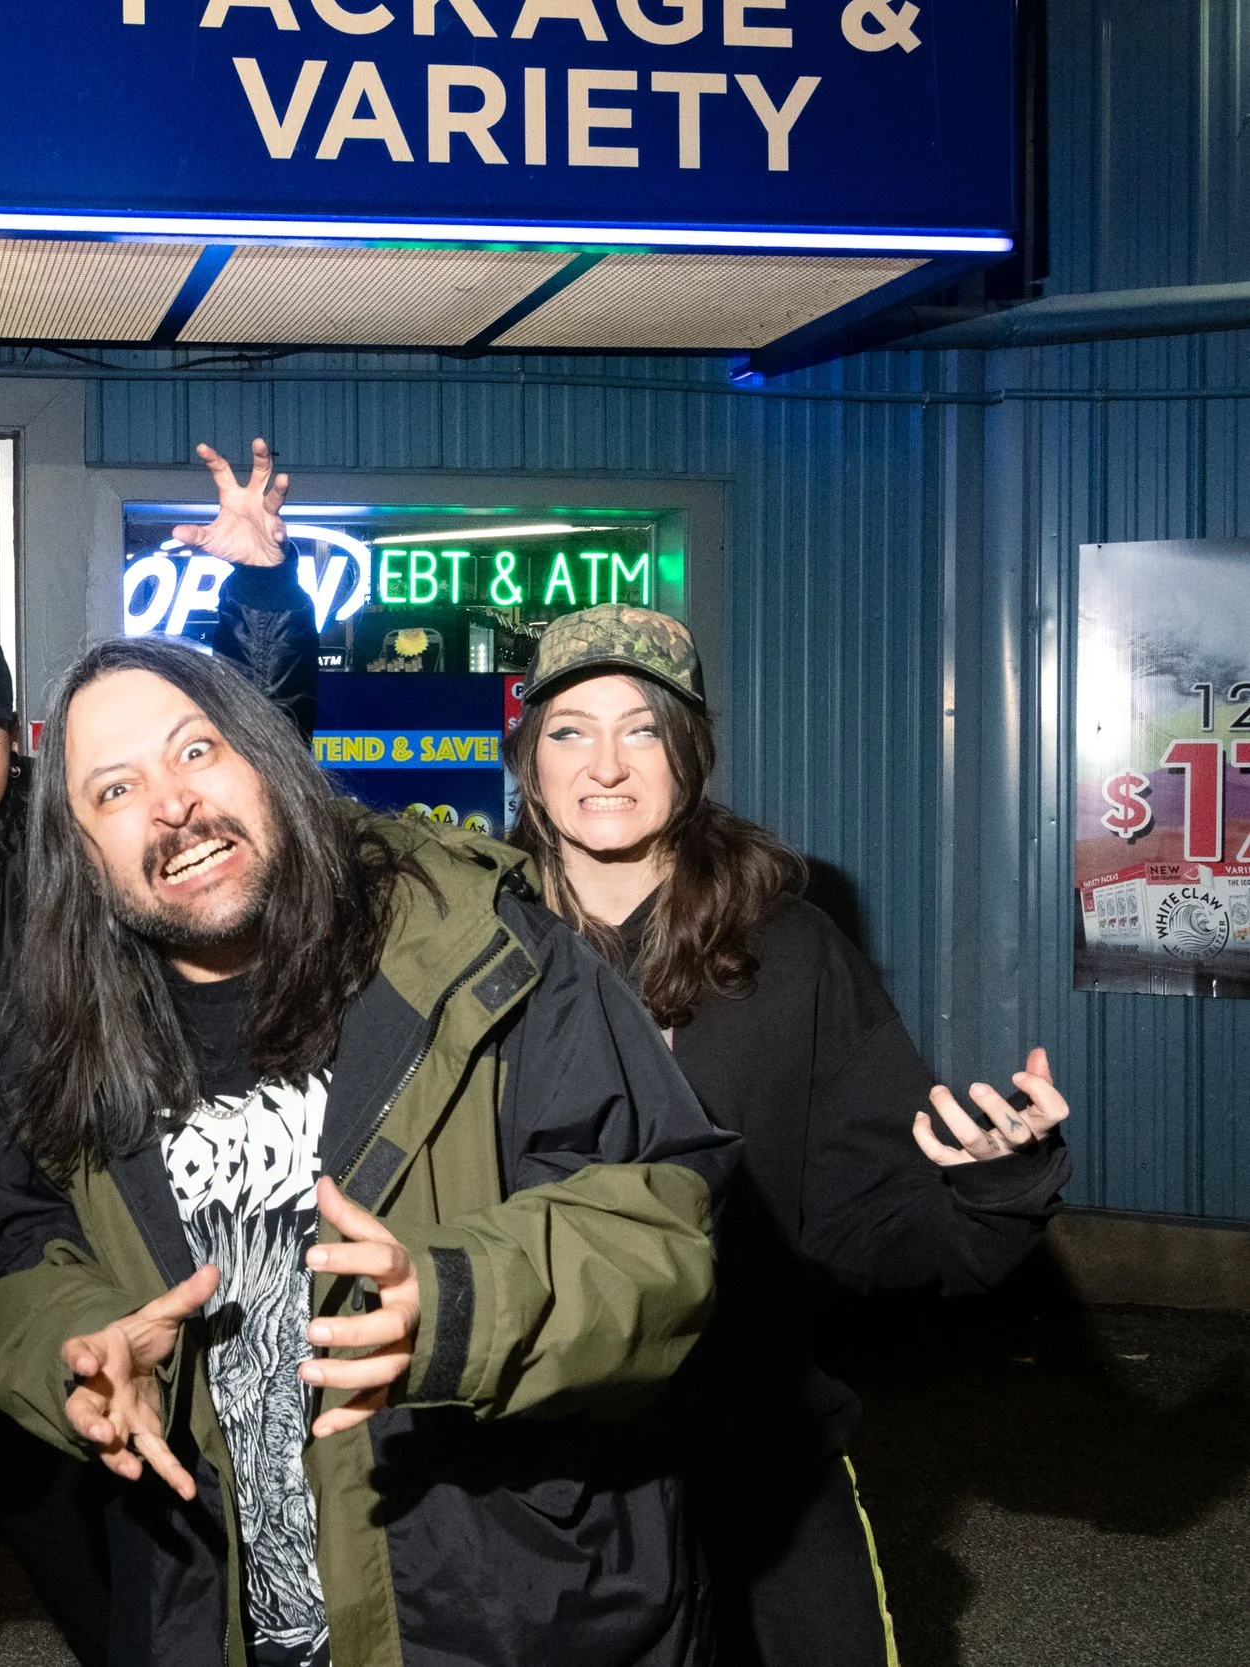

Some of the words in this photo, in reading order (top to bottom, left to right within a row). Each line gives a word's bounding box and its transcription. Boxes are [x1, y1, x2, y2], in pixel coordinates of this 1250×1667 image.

[232, 57, 822, 172] VARIETY
[380, 550, 470, 604] EBT
[490, 550, 523, 606] &
[544, 552, 650, 606] ATM
[391, 736, 414, 762] &
[420, 736, 500, 762] SAVE!
[1150, 865, 1180, 875] NEW
[1156, 892, 1181, 939] WHITE
[1181, 887, 1223, 911] CLAW
